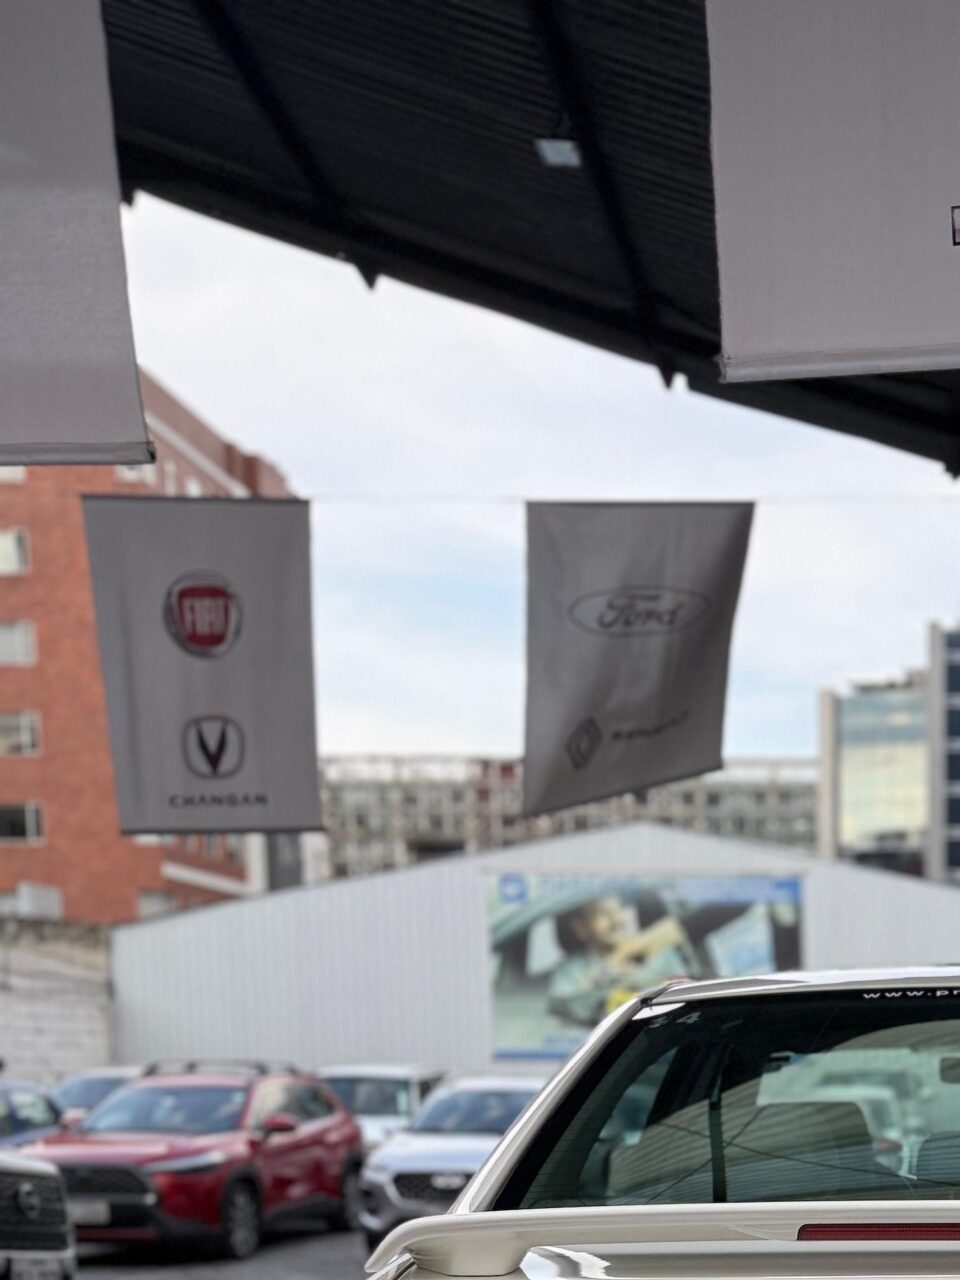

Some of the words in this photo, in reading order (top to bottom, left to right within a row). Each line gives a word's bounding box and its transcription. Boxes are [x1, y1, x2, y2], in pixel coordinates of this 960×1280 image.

[181, 597, 227, 637] FIAT
[597, 592, 684, 629] Ford
[168, 792, 269, 809] CHANGAN
